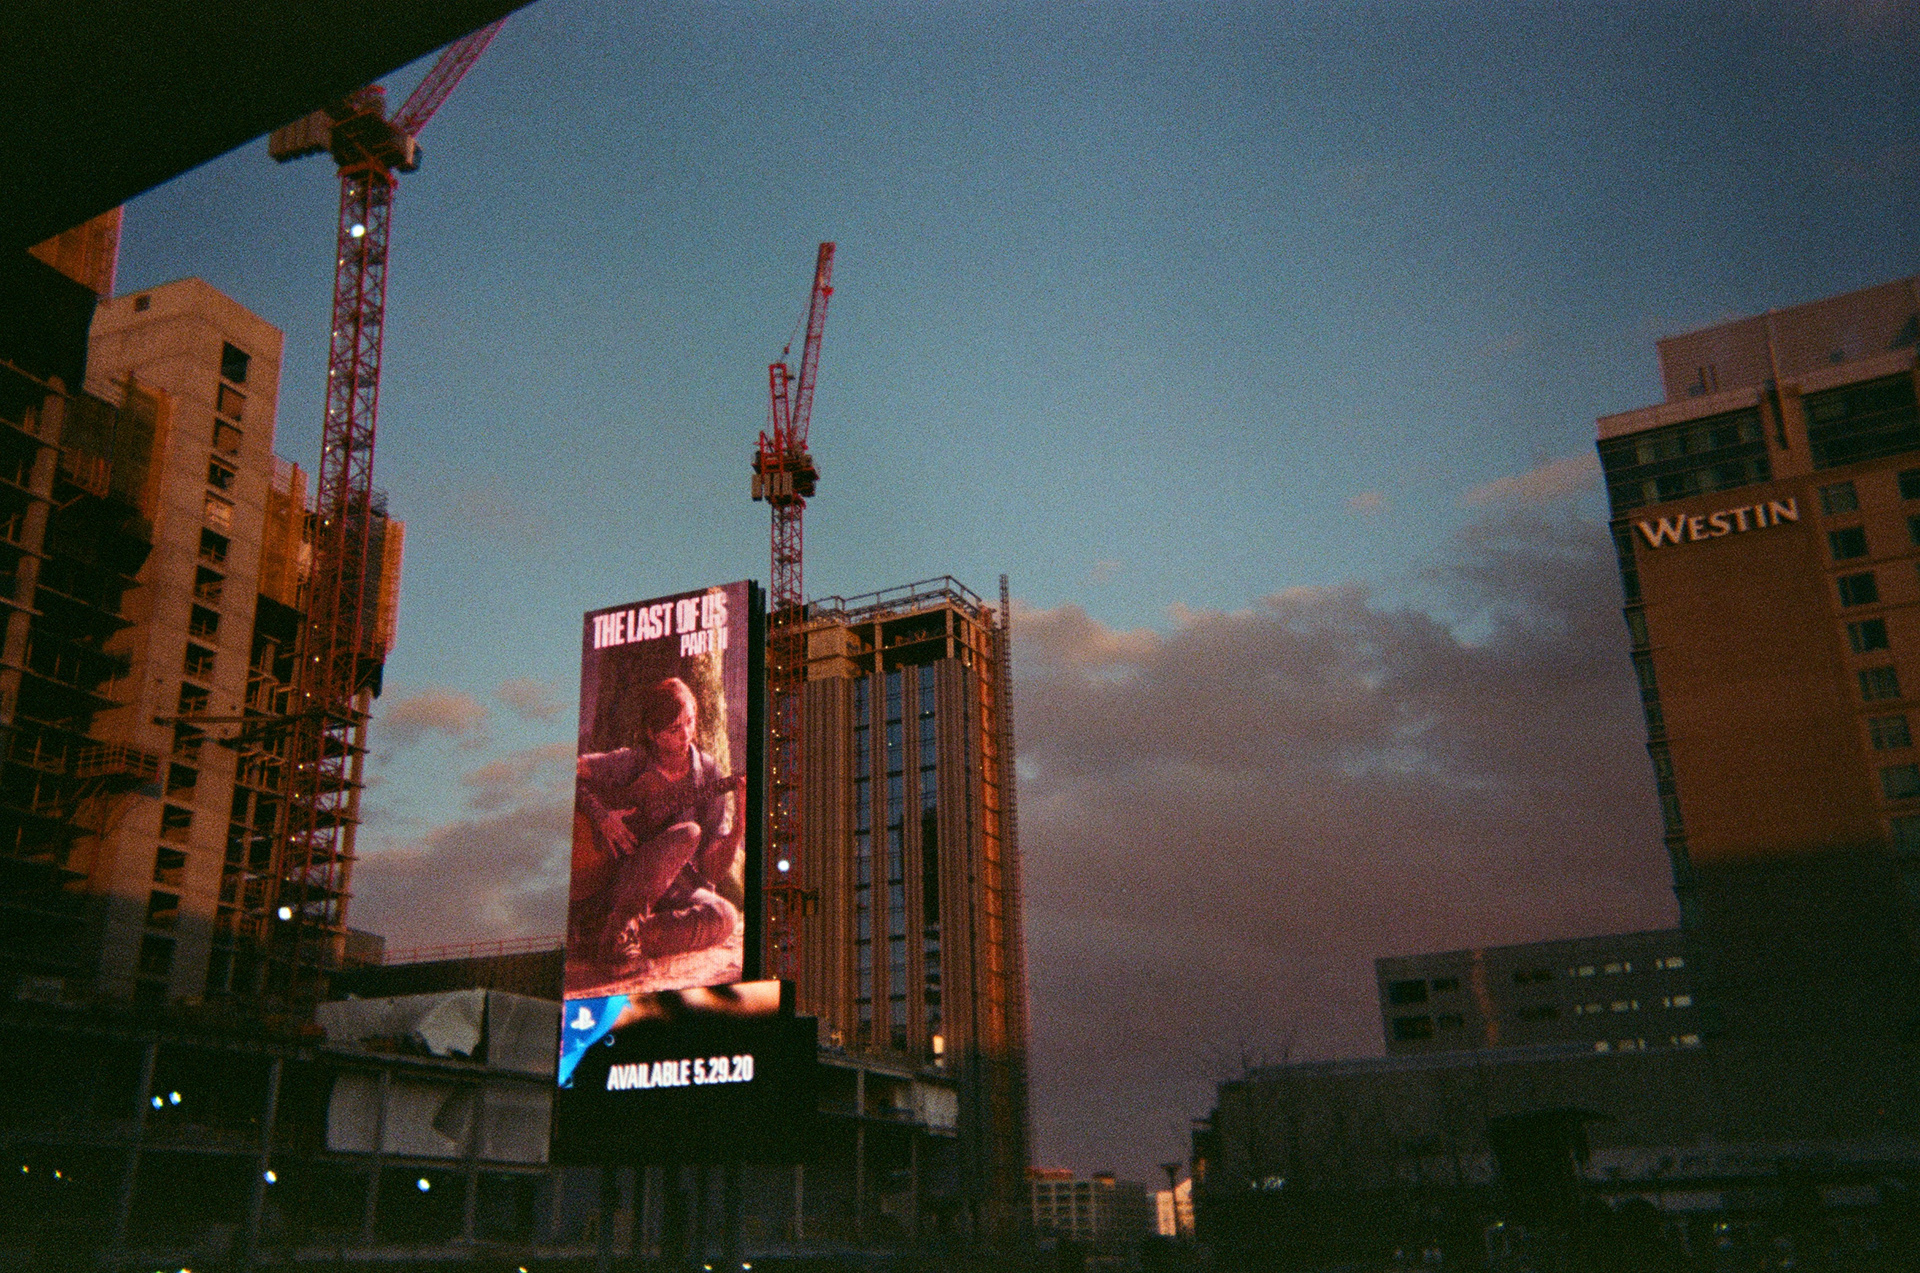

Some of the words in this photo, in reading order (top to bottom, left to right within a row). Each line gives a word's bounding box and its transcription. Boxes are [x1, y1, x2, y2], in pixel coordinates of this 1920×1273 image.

[1638, 498, 1798, 548] WESTIN
[593, 611, 627, 650] THE
[627, 602, 675, 643] LAST
[676, 597, 701, 634] OF
[701, 592, 728, 630] US
[680, 630, 714, 657] PART
[607, 1060, 691, 1090] AVAILABLE
[693, 1055, 754, 1085] 5.29.20
